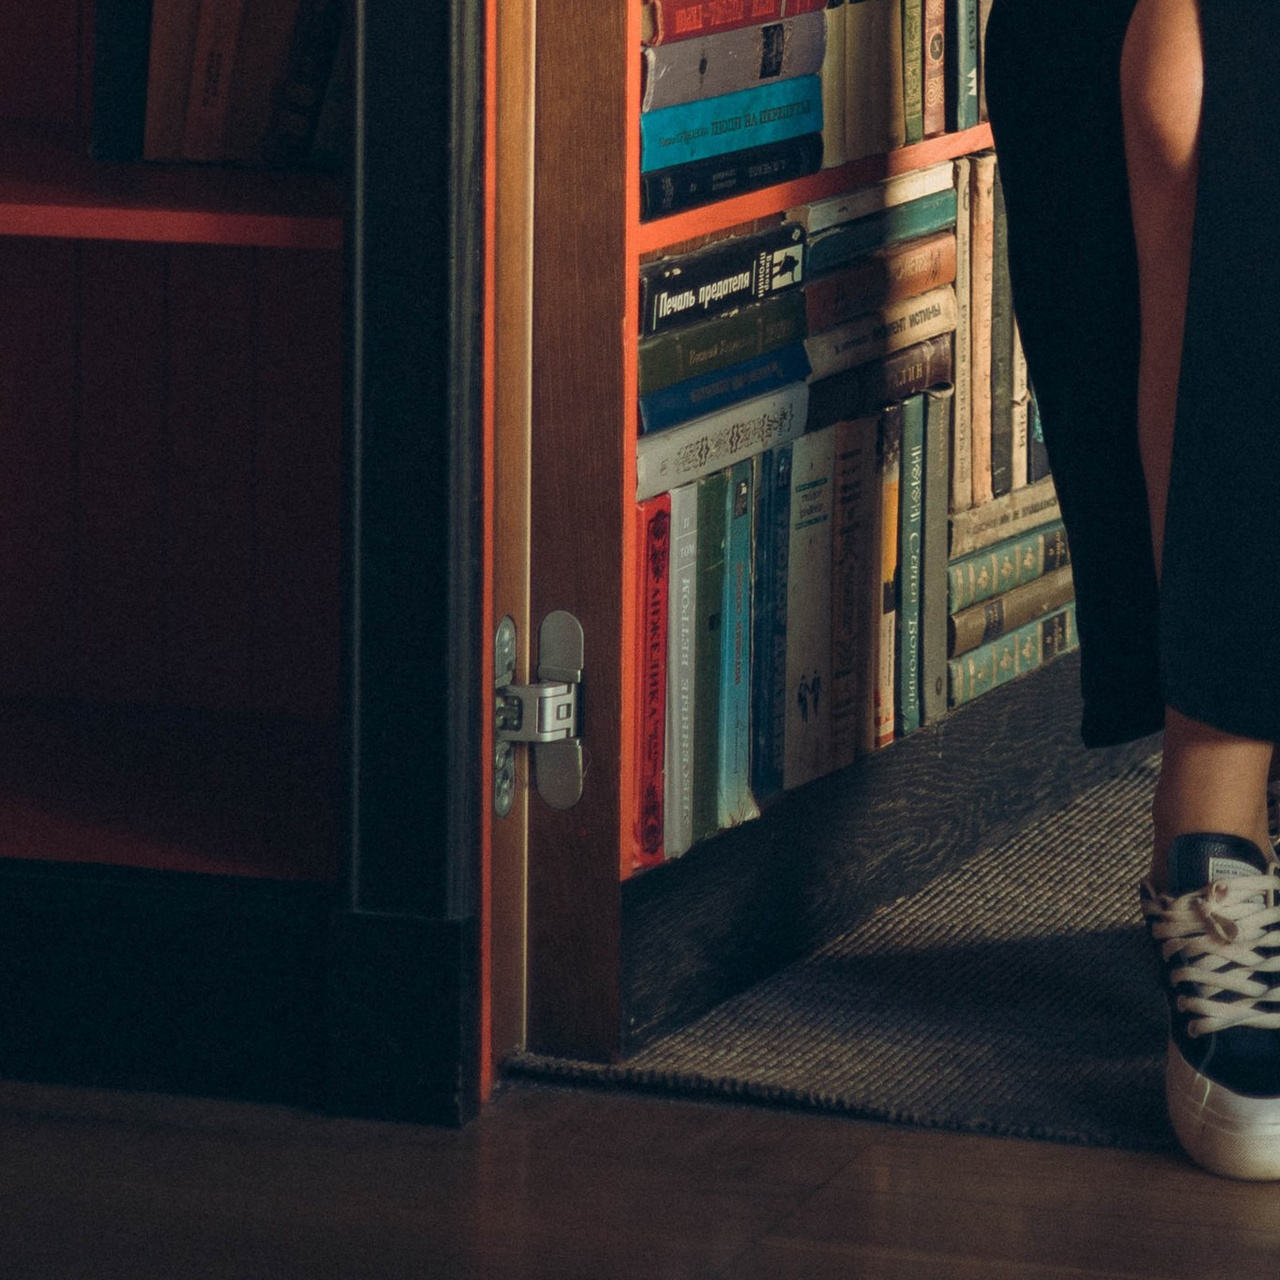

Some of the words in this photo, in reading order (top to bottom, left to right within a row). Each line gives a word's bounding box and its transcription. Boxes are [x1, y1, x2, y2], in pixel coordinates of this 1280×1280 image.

[658, 285, 697, 320] Печаль
[698, 267, 751, 315] предателя
[756, 251, 767, 299] ПРОНИН
[765, 252, 775, 294] Виктор
[909, 302, 941, 327] ИСТИНЫ
[680, 576, 691, 666] ВЕТРОМ
[648, 586, 661, 721] АНЖЕЛИКА
